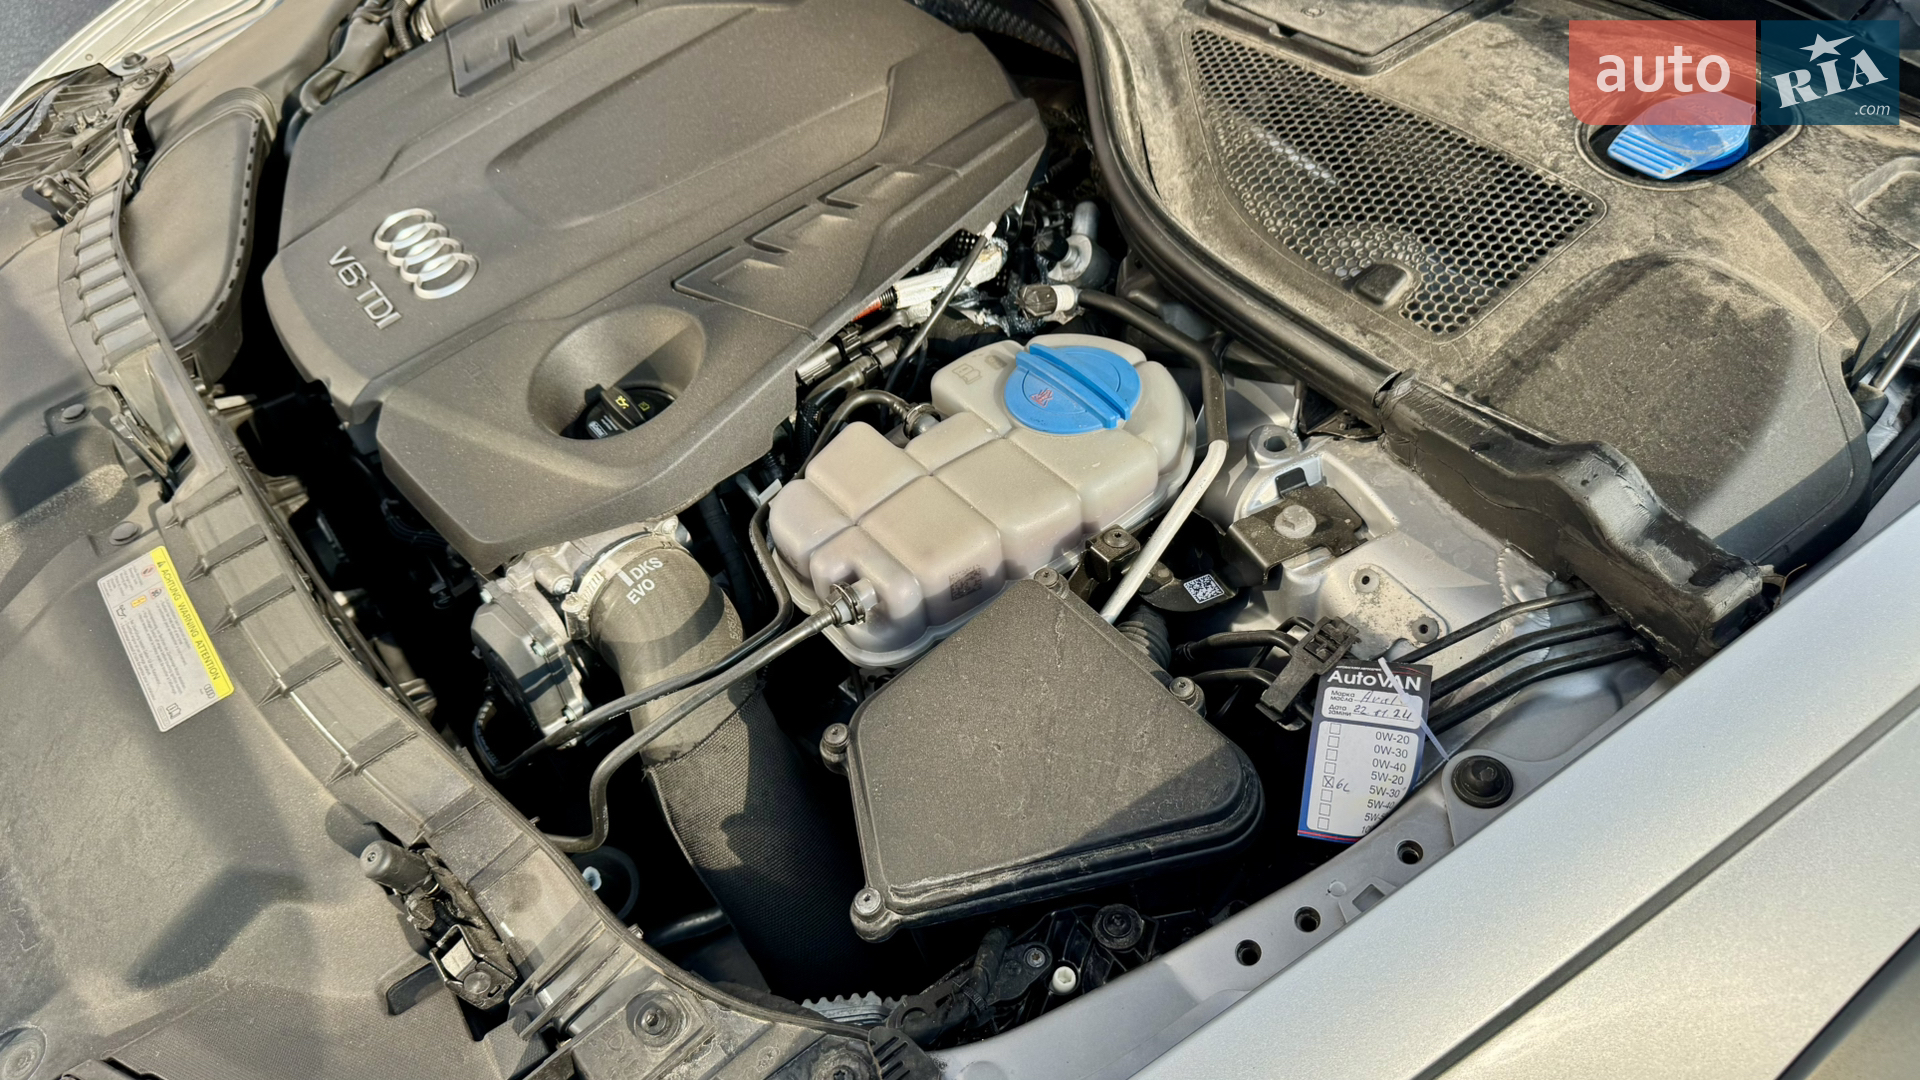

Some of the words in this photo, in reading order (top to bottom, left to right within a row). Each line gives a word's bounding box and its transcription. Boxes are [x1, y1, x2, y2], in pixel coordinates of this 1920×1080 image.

[328, 245, 367, 287] V6
[356, 280, 402, 330] TDI
[626, 578, 656, 606] EVO
[161, 569, 181, 601] ACHTUNG
[178, 603, 199, 638] WARNING
[195, 640, 221, 681] ATTENTION
[1327, 670, 1422, 692] AutoVAN
[1331, 690, 1355, 698] Марка
[1375, 731, 1410, 745] 0W-20
[1373, 744, 1408, 759] 0W-30
[1372, 758, 1407, 773] 0W-40
[1370, 771, 1404, 785] 5W-20
[1369, 785, 1401, 798] 5W-30
